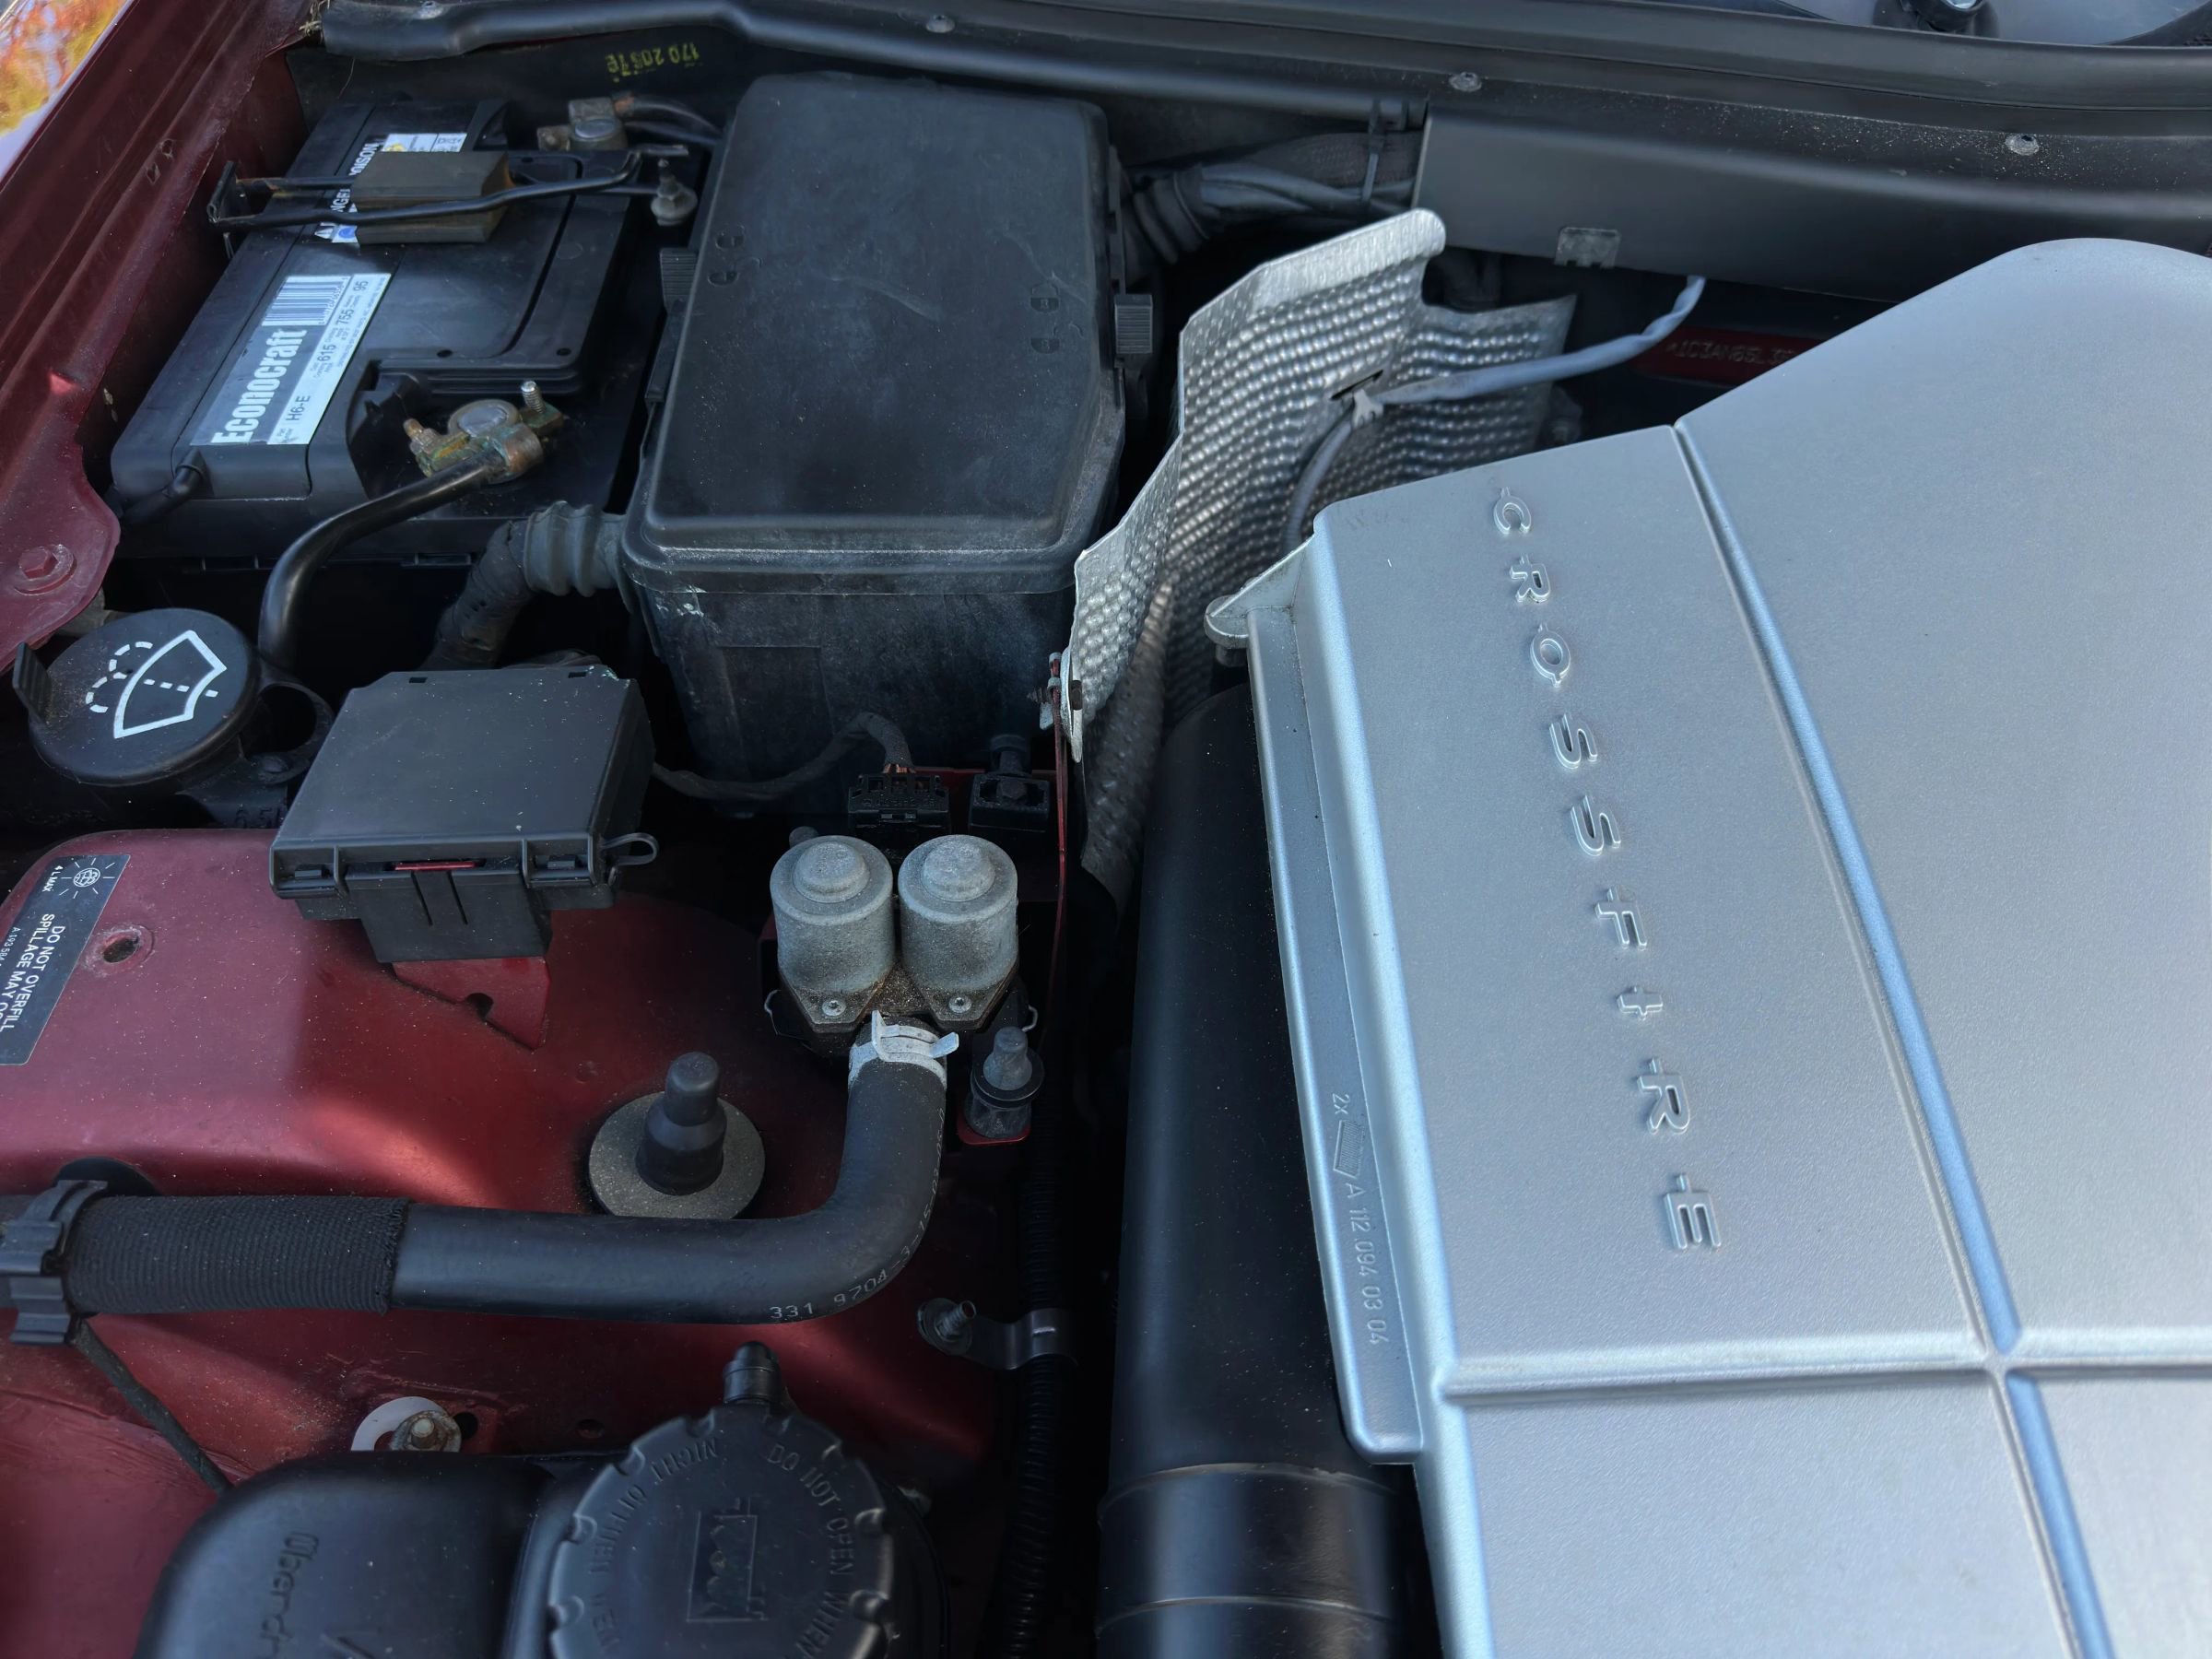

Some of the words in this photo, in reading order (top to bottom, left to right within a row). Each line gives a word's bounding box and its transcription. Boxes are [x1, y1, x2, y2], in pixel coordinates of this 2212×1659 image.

[286, 394, 311, 422] H6-E
[317, 344, 337, 363] 615
[339, 308, 355, 325] 755
[353, 280, 369, 292] 95
[210, 328, 308, 443] Econocraft
[1492, 486, 1724, 1252] CROSSFIRE
[16, 913, 55, 968] SPILLAGE
[32, 947, 54, 971] NOT
[47, 926, 65, 944] DO
[0, 974, 40, 1032] OVERFILL
[1, 971, 27, 999] MAY
[1346, 1182, 1366, 1199] A
[770, 1302, 814, 1320] 331
[766, 1441, 801, 1472] DO
[798, 1465, 842, 1509] NOT
[826, 1516, 855, 1577] OPEN
